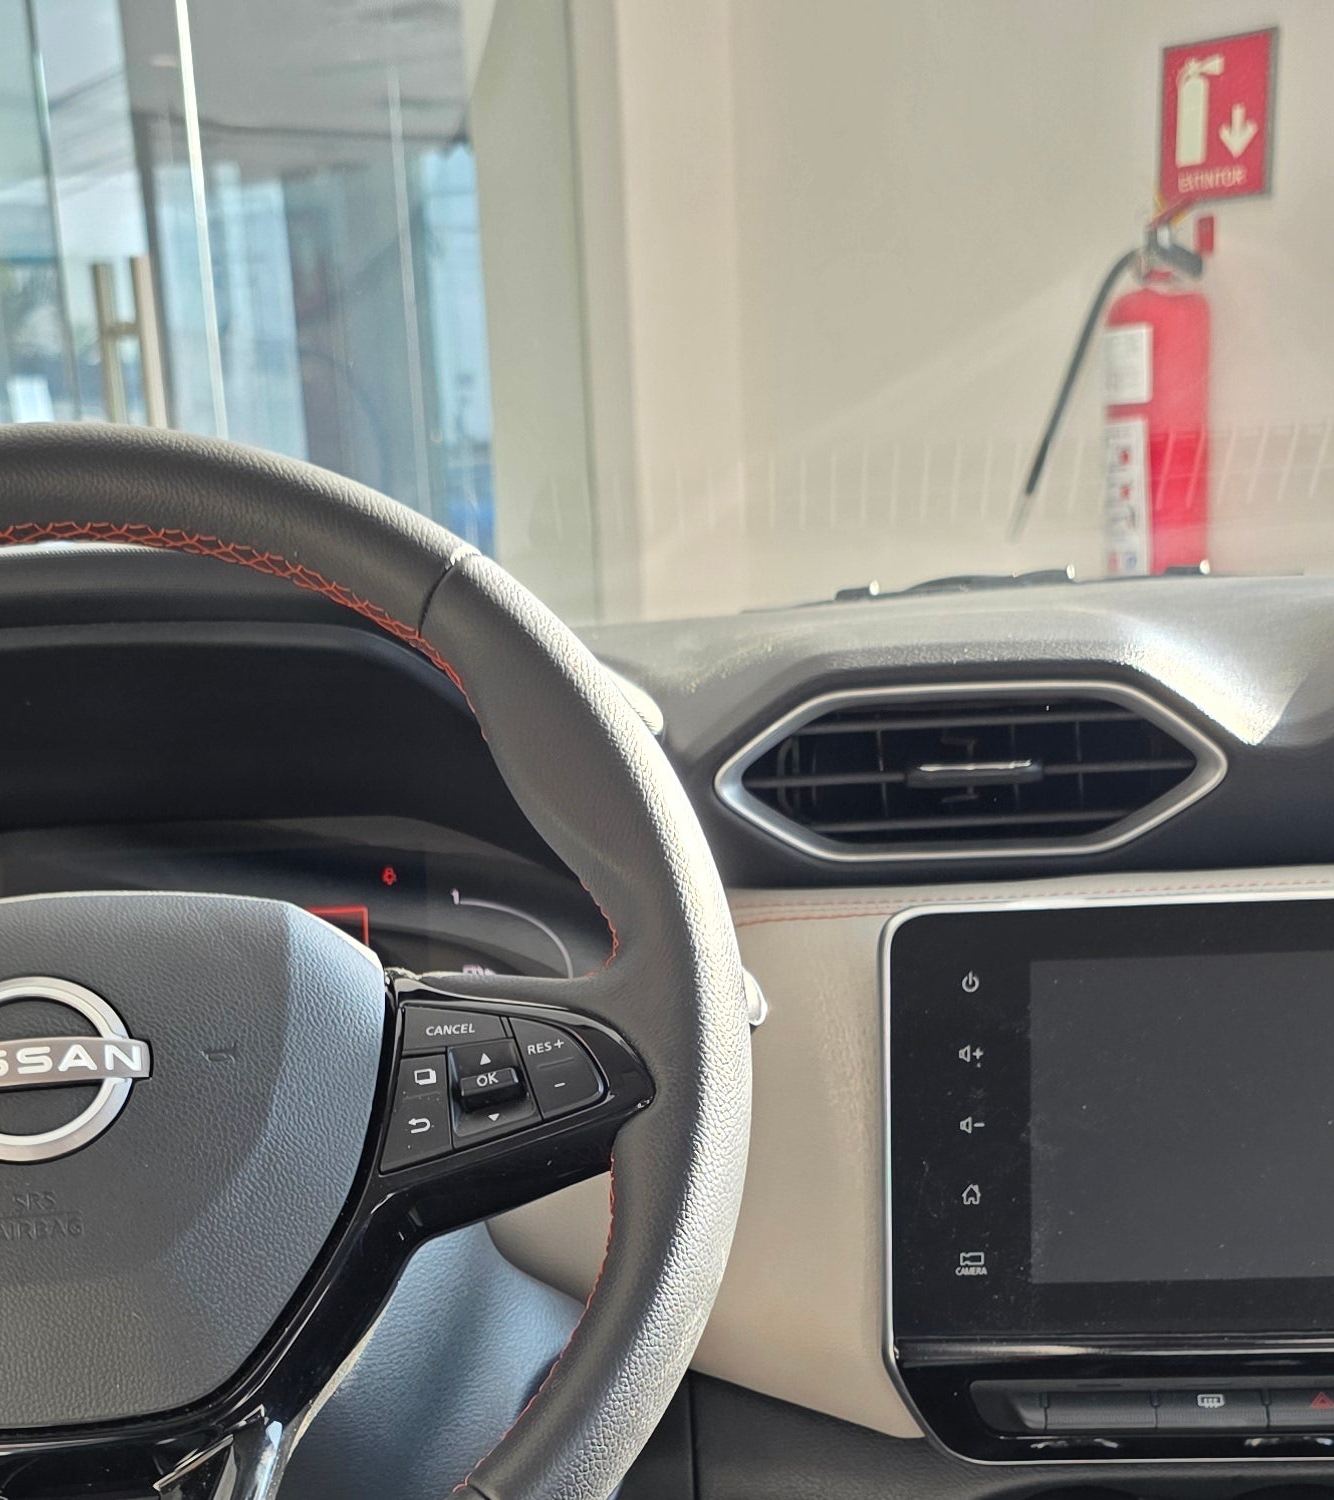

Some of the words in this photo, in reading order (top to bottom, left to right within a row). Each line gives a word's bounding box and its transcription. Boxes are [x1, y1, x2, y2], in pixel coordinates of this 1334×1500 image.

[425, 1023, 476, 1037] CANCEL
[475, 1072, 499, 1087] OK
[955, 1266, 988, 1276] CAMERA
